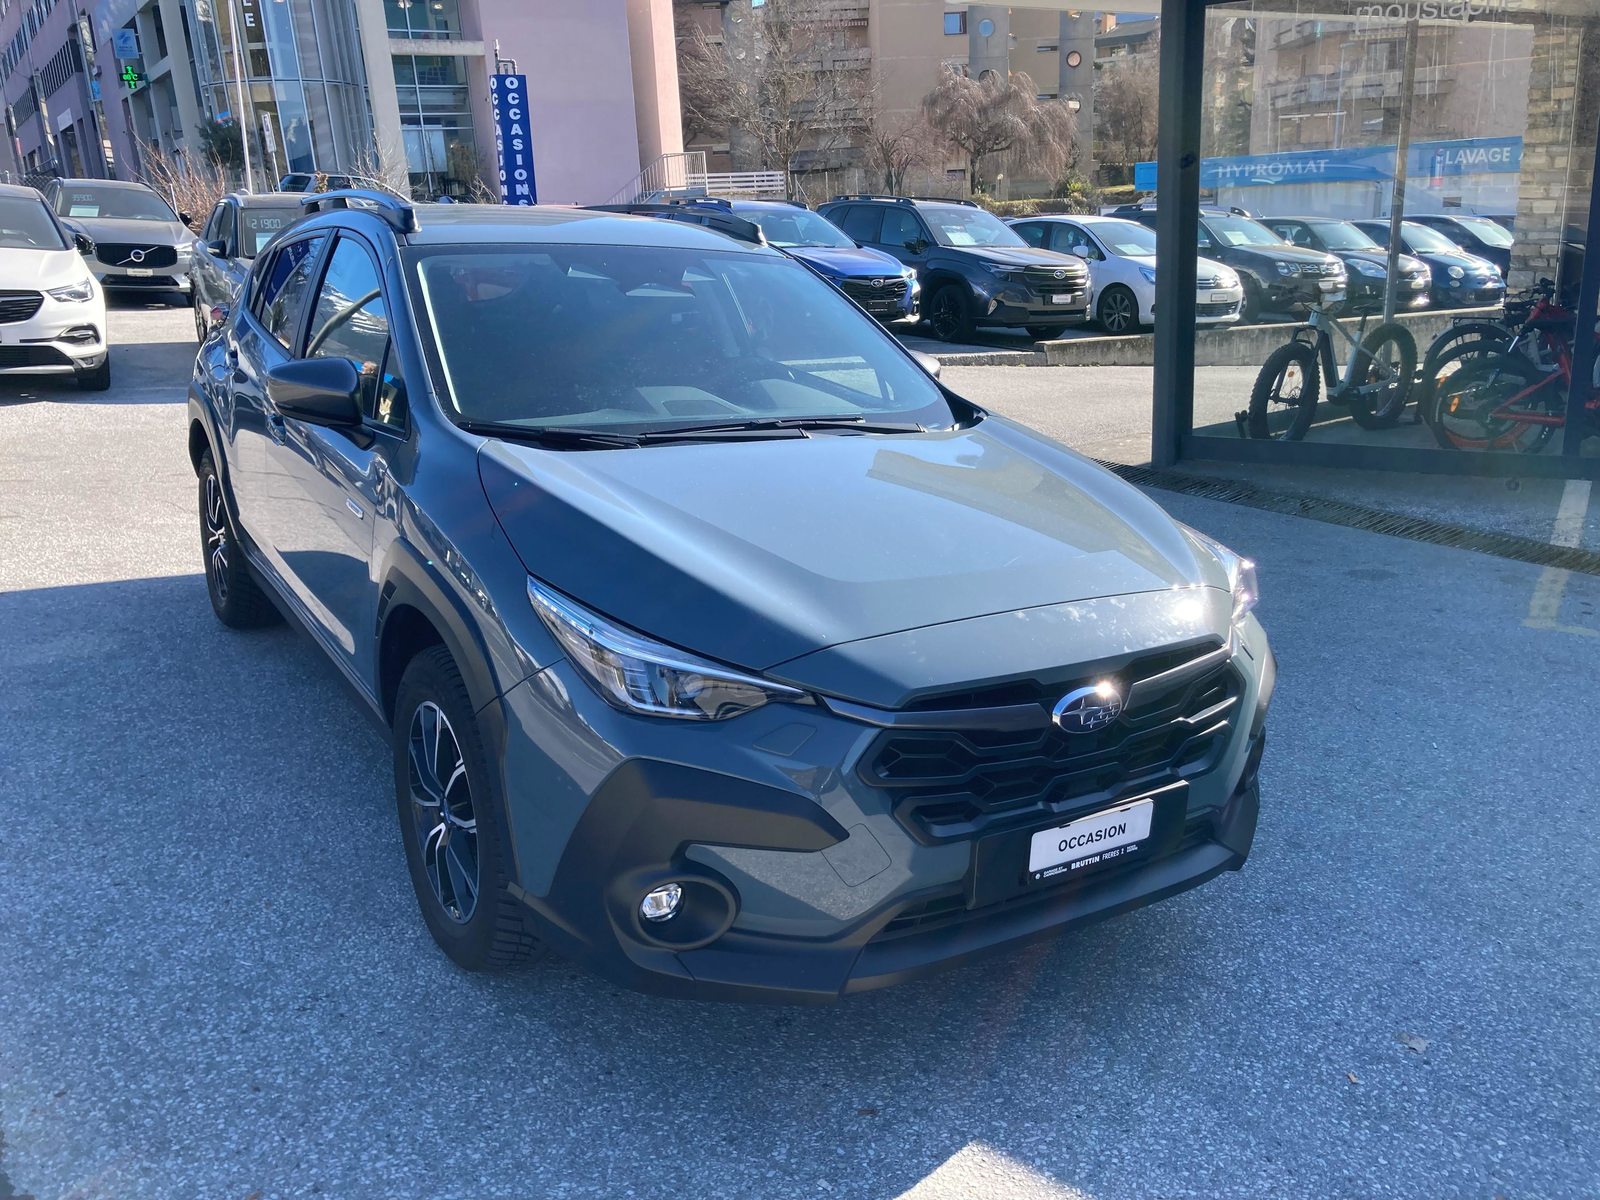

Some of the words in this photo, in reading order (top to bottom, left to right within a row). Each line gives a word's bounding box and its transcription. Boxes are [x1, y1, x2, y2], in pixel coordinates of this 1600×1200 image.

[1445, 147, 1511, 165] LAVAGE
[1217, 159, 1329, 178] HYPROMAT
[1058, 823, 1127, 852] OCCASION
[1071, 855, 1100, 870] BRUTTIN
